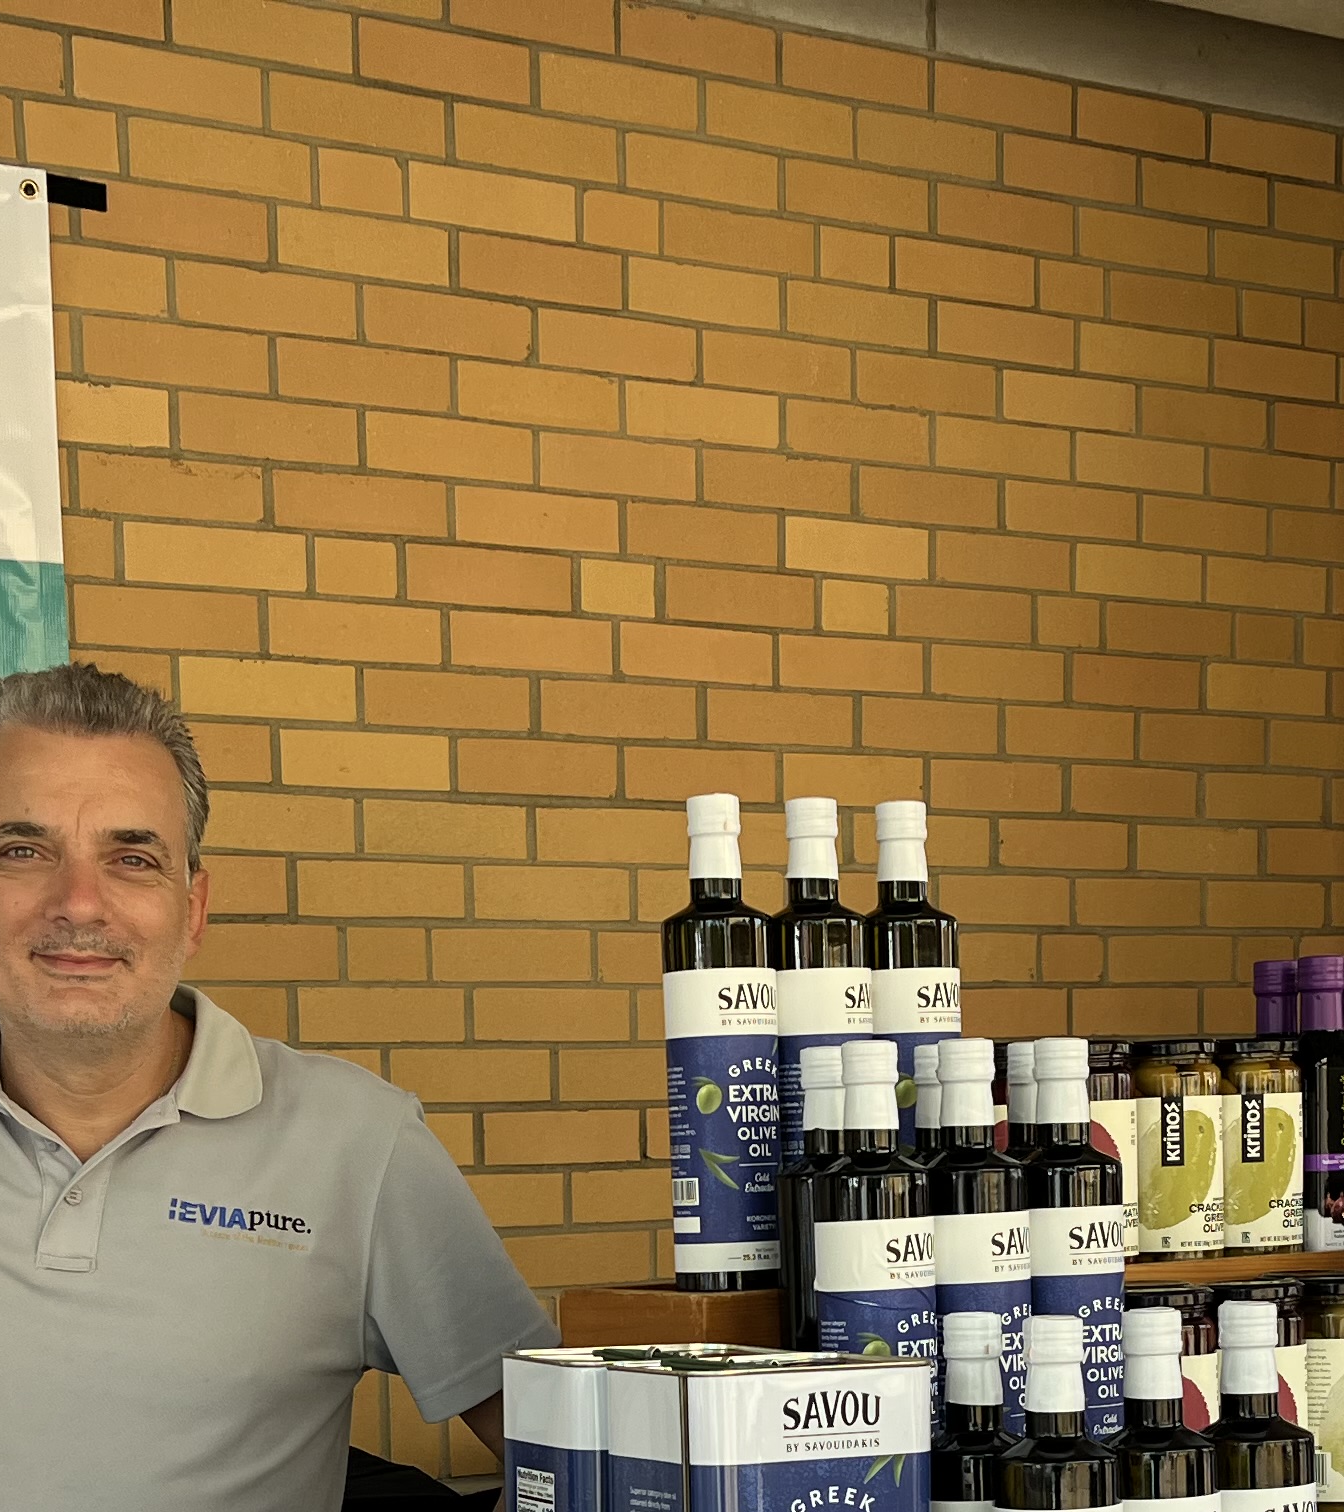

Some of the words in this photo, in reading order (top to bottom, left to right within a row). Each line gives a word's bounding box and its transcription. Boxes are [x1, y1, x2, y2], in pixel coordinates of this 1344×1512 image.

[728, 1085, 778, 1103] EXTRA
[737, 1126, 777, 1141] OLIVE
[748, 1142, 772, 1158] OIL
[782, 1390, 881, 1431] SAVOU
[786, 1442, 799, 1453] BY
[805, 1438, 880, 1451] SAVOUIDAKIS
